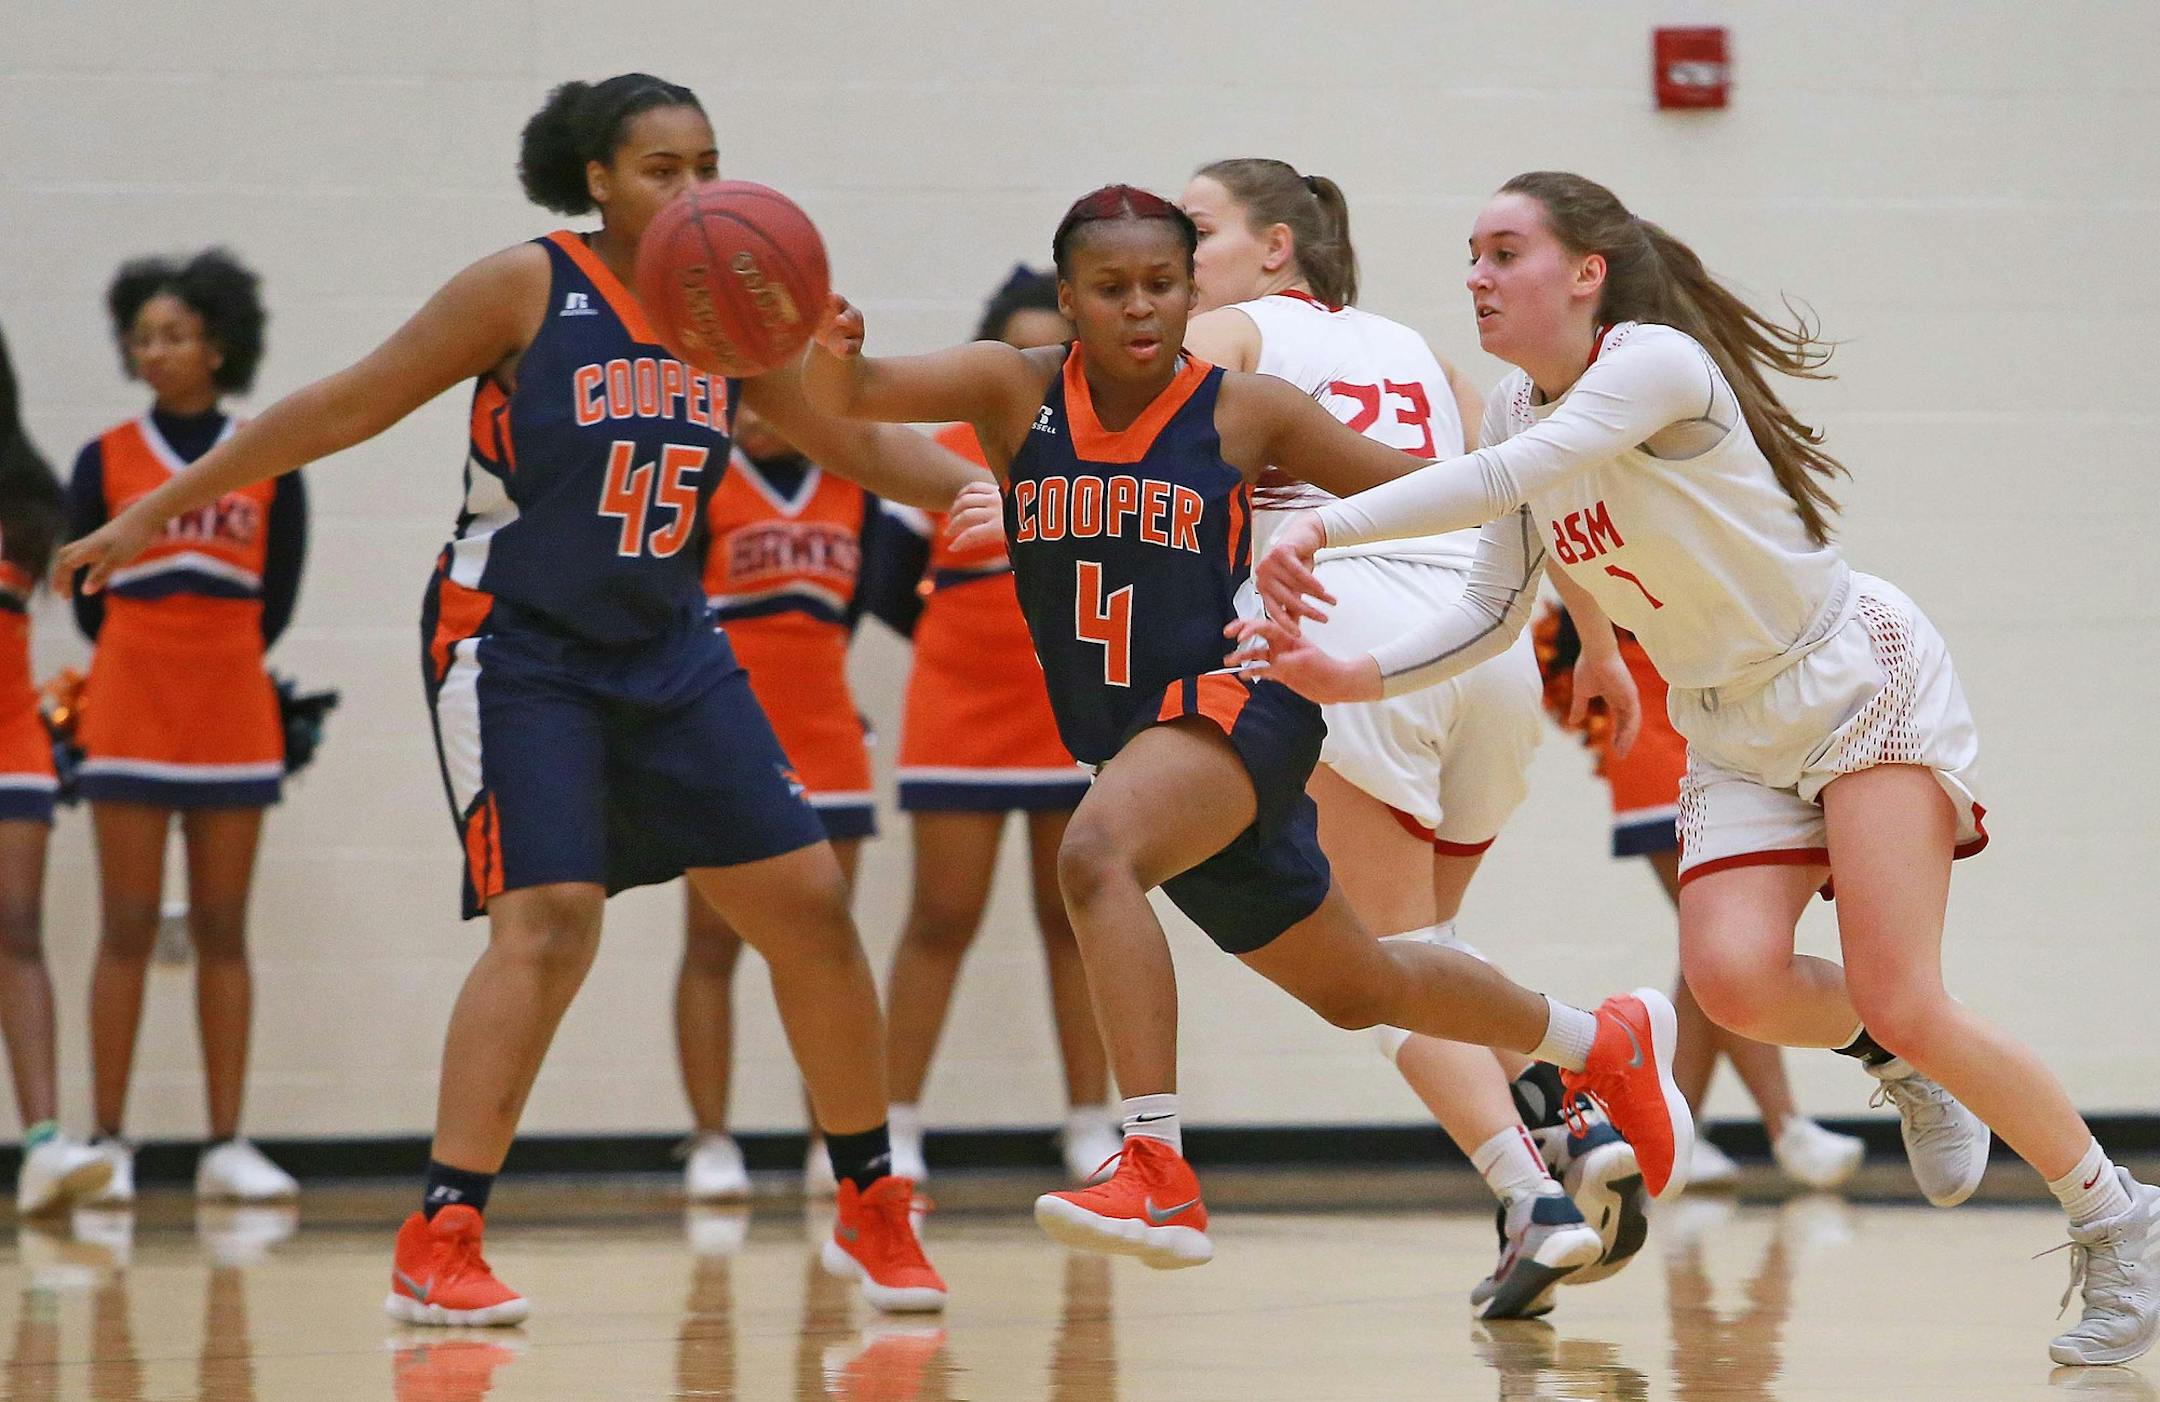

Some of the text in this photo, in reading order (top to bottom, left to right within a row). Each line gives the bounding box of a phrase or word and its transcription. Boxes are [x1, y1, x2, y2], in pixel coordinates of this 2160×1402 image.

[574, 357, 729, 438] COOPER
[1031, 421, 1057, 434] SSELL
[598, 440, 709, 558] 45
[1015, 475, 1203, 554] COOPER
[1075, 560, 1133, 688] 4
[1604, 564, 1664, 609] 1
